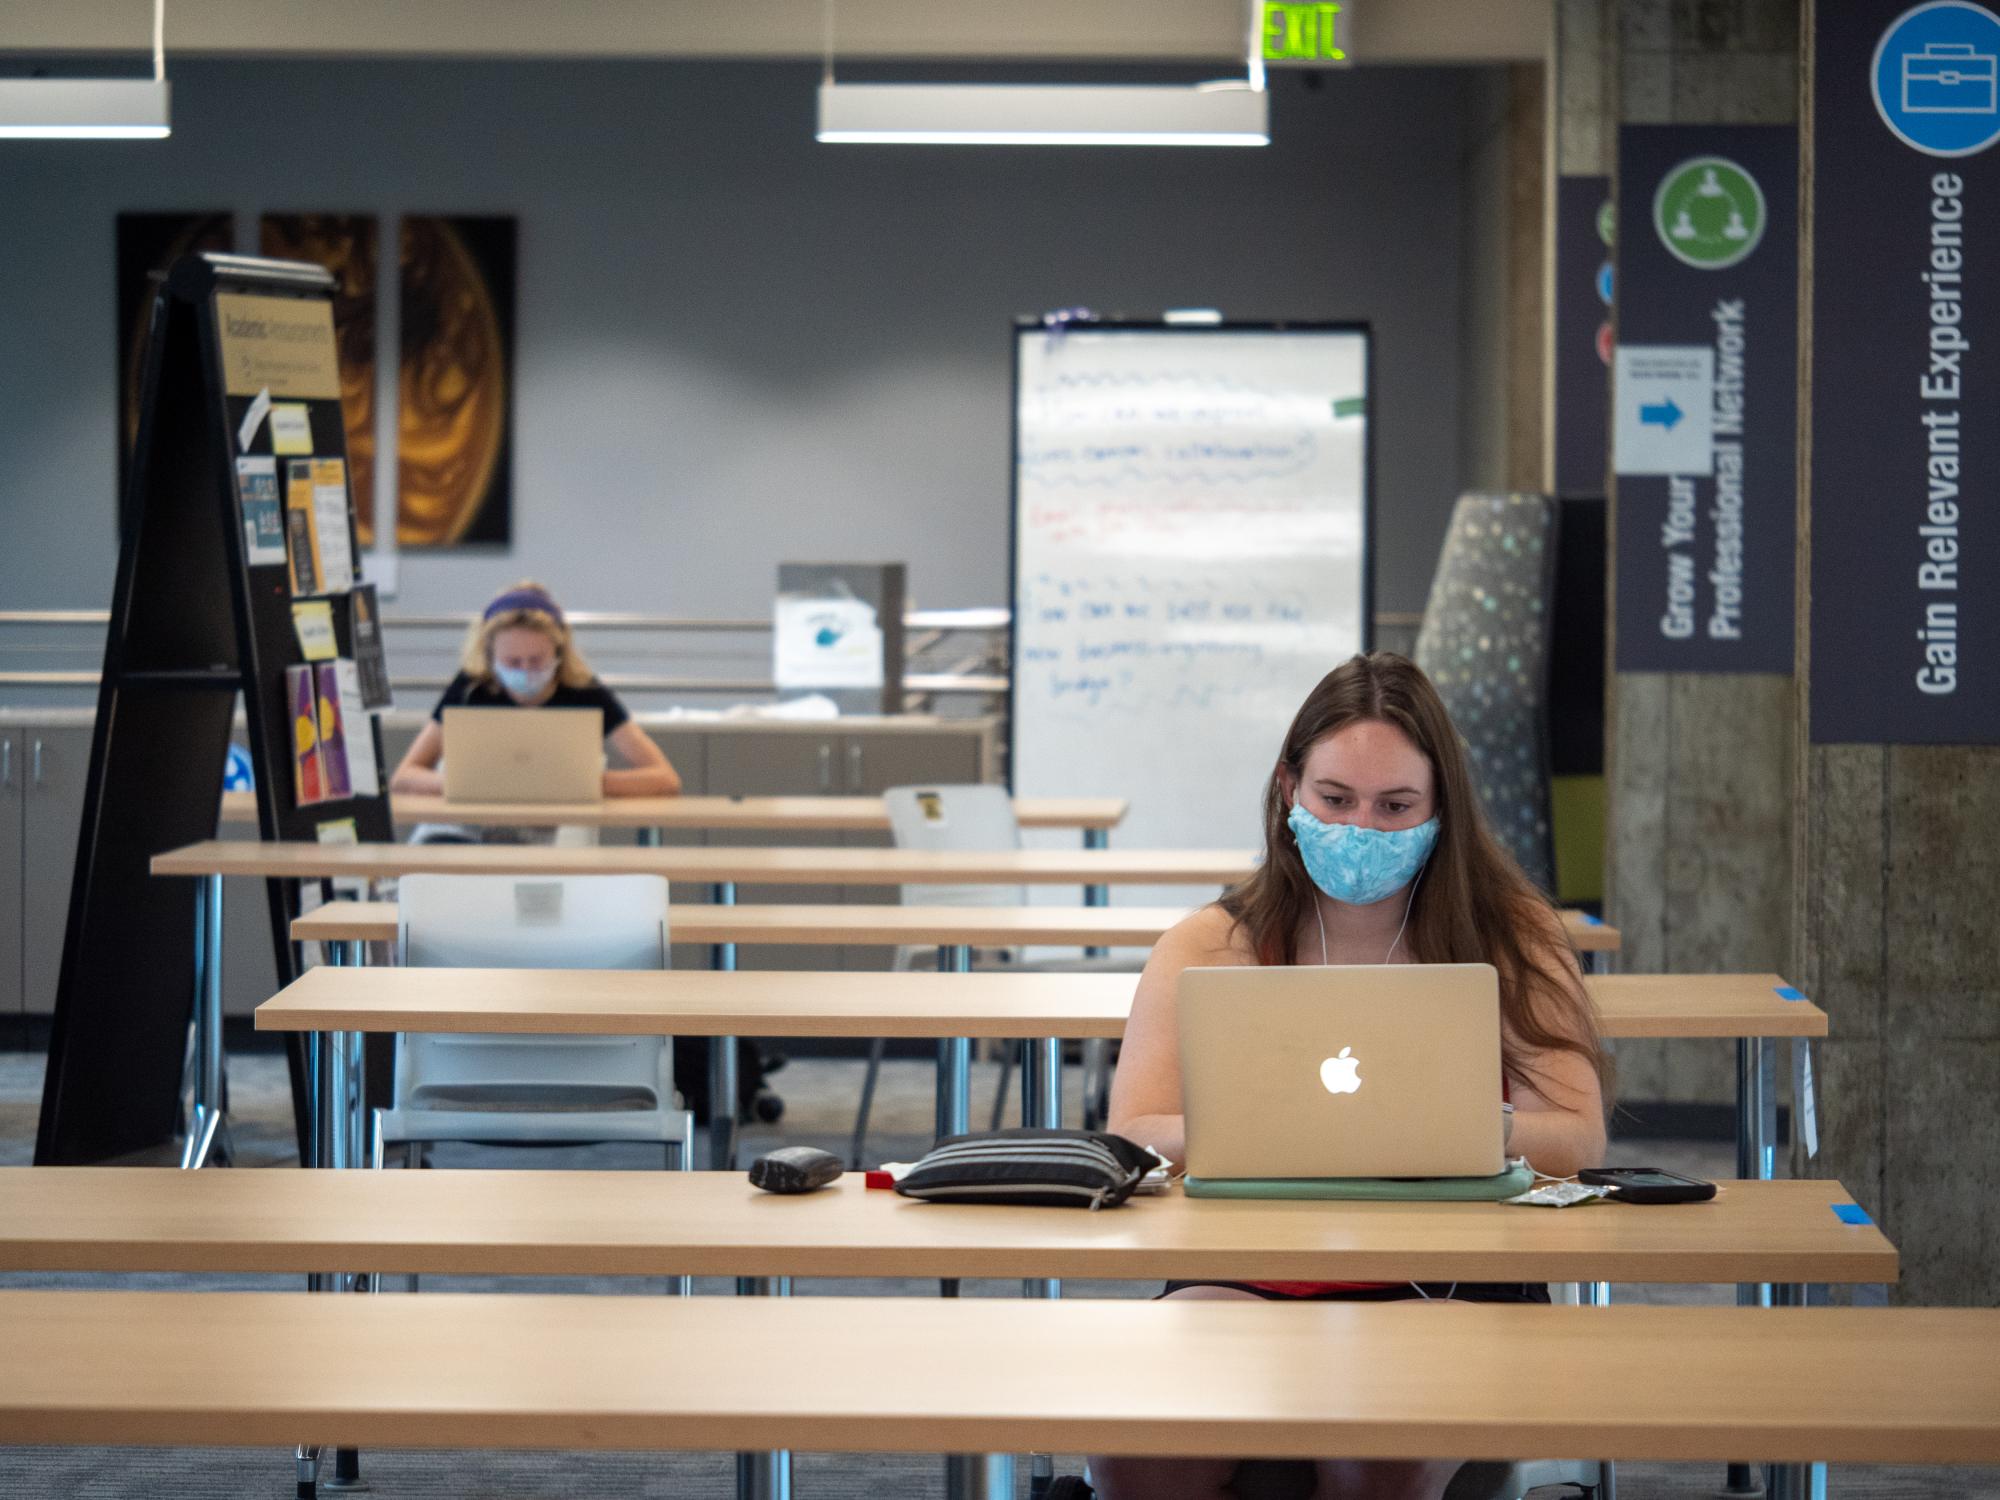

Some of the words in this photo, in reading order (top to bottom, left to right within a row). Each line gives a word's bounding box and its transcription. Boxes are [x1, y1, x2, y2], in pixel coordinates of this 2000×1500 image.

[1263, 2, 1343, 60] EXIT
[1920, 173, 1969, 399] Experience
[1711, 299, 1745, 433] Network
[1661, 475, 1696, 547] Your
[1708, 442, 1743, 638] Professional
[1919, 411, 1960, 589] Relevant
[1660, 553, 1695, 638] Grow
[1916, 604, 1957, 694] Gain
